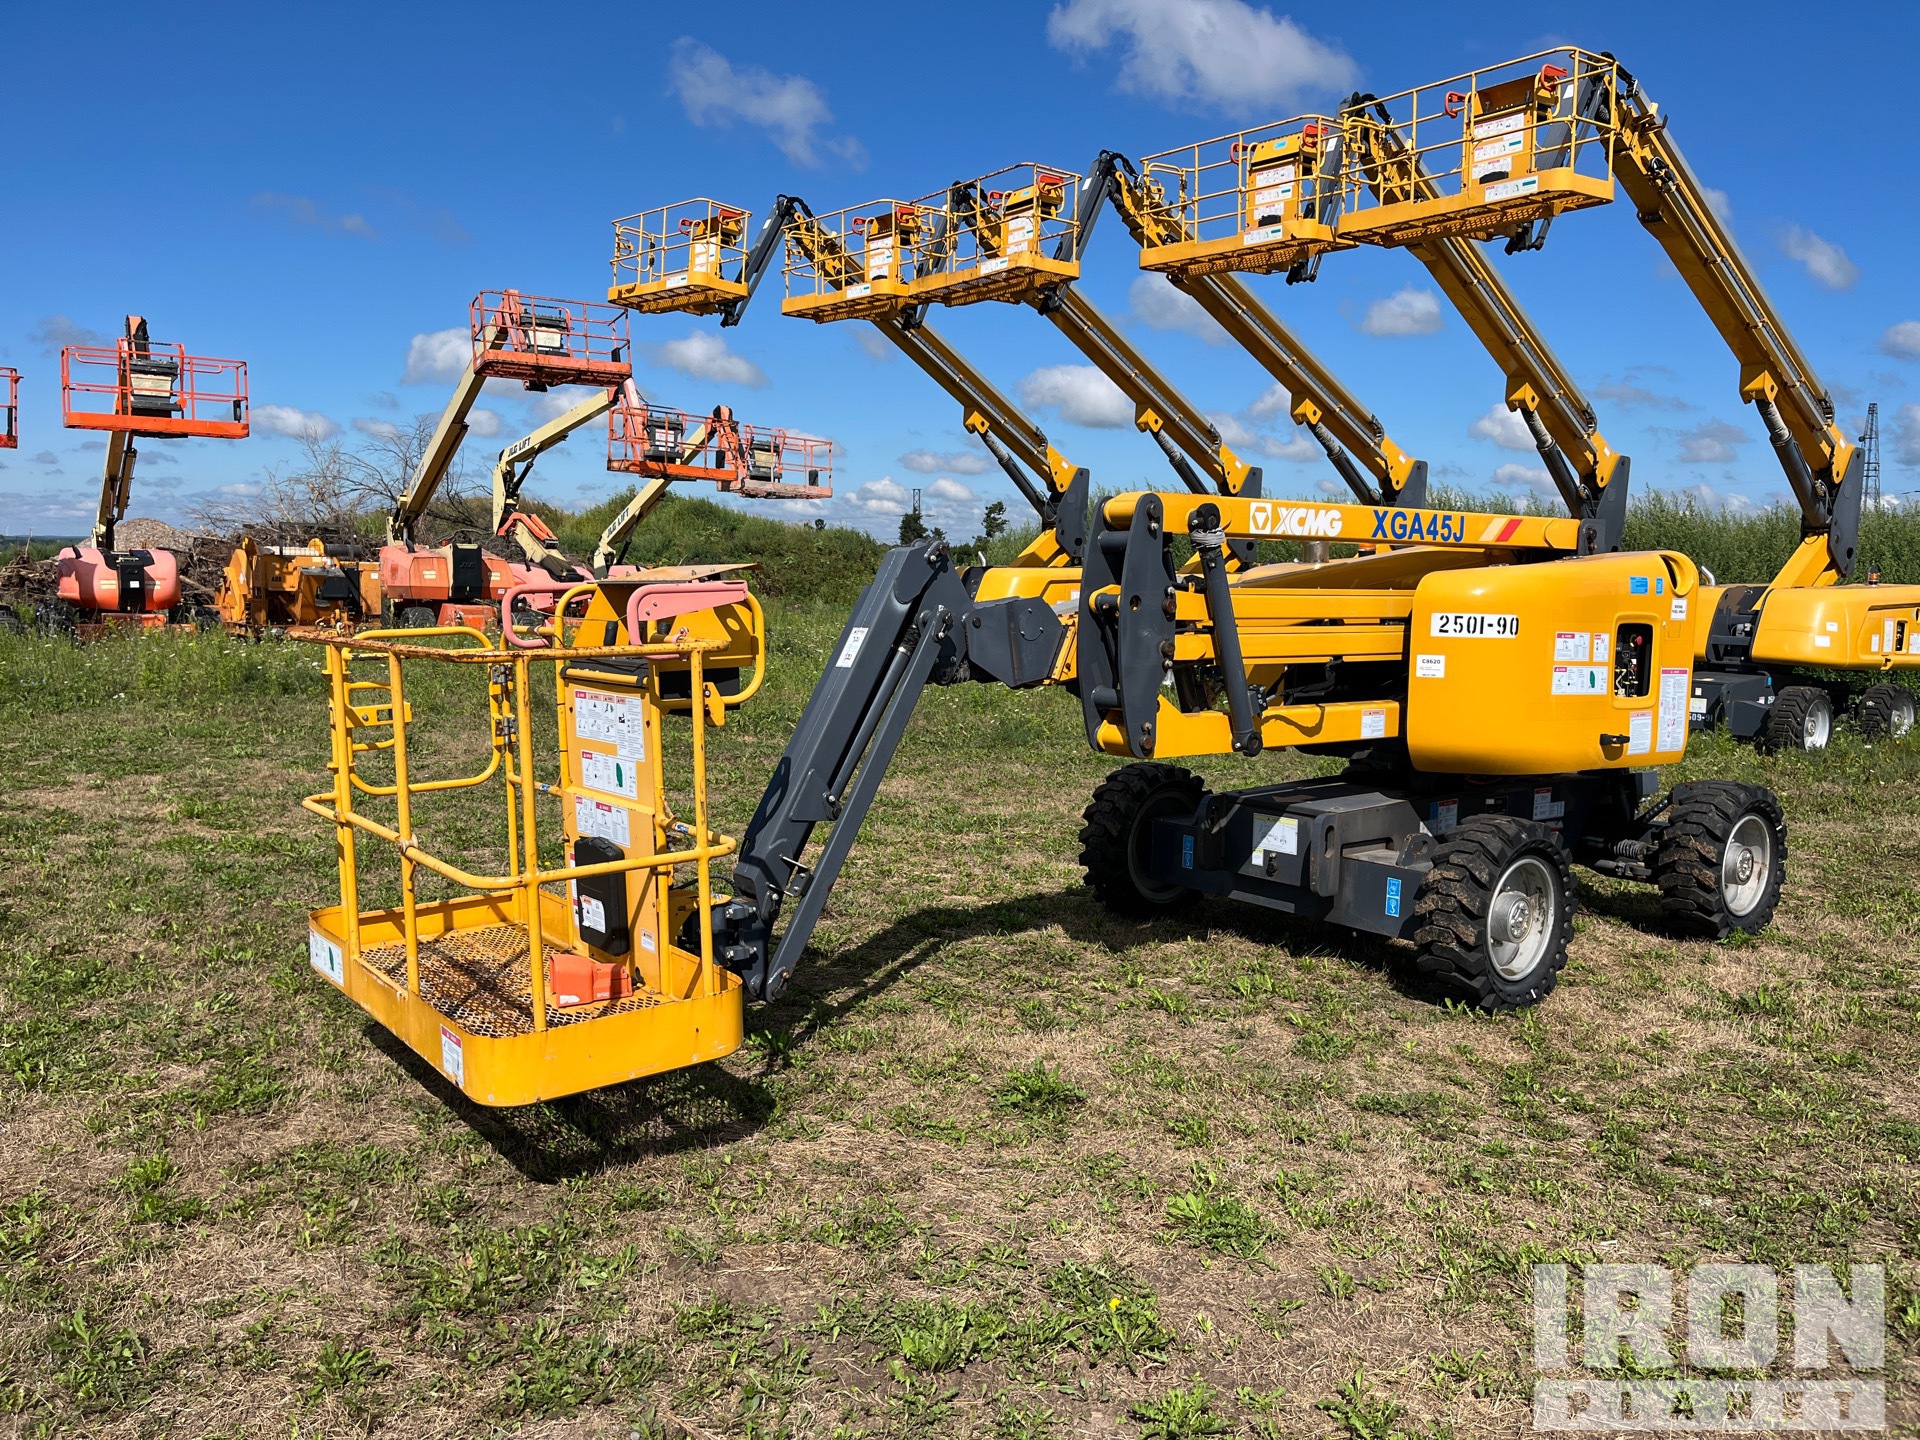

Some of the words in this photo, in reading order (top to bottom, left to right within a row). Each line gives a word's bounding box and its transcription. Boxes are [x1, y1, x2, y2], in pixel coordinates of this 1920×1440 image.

[519, 436, 531, 451] LIFT
[617, 507, 629, 527] LIFT
[1272, 507, 1343, 537] XCMG
[1371, 509, 1465, 543] XGA45J
